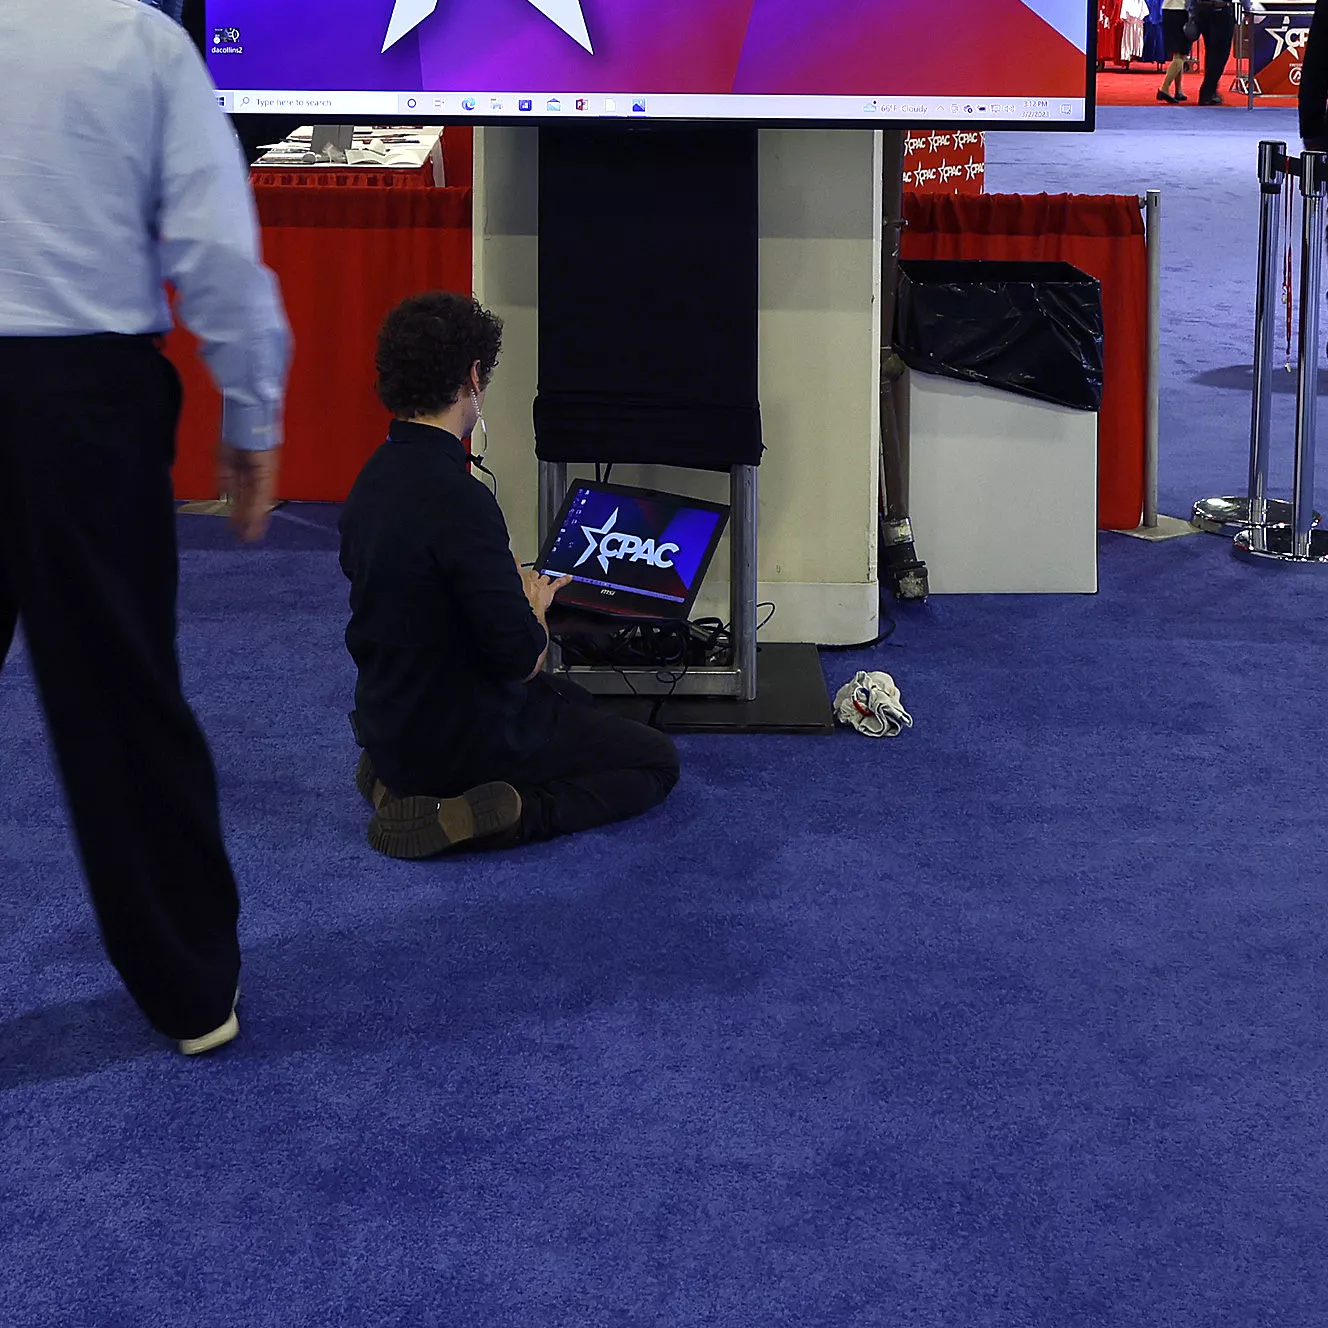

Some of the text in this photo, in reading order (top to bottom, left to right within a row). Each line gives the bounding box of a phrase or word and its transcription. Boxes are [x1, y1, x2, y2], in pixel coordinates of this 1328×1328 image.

[1285, 28, 1310, 48] CP
[211, 46, 243, 54] dacollins2
[256, 98, 274, 107] Type
[901, 104, 928, 114] Cloudy
[908, 132, 978, 150] CPAC CPAC CPAC
[919, 168, 937, 181] CPAC
[943, 164, 962, 177] CPAC
[599, 532, 680, 569] CPAC
